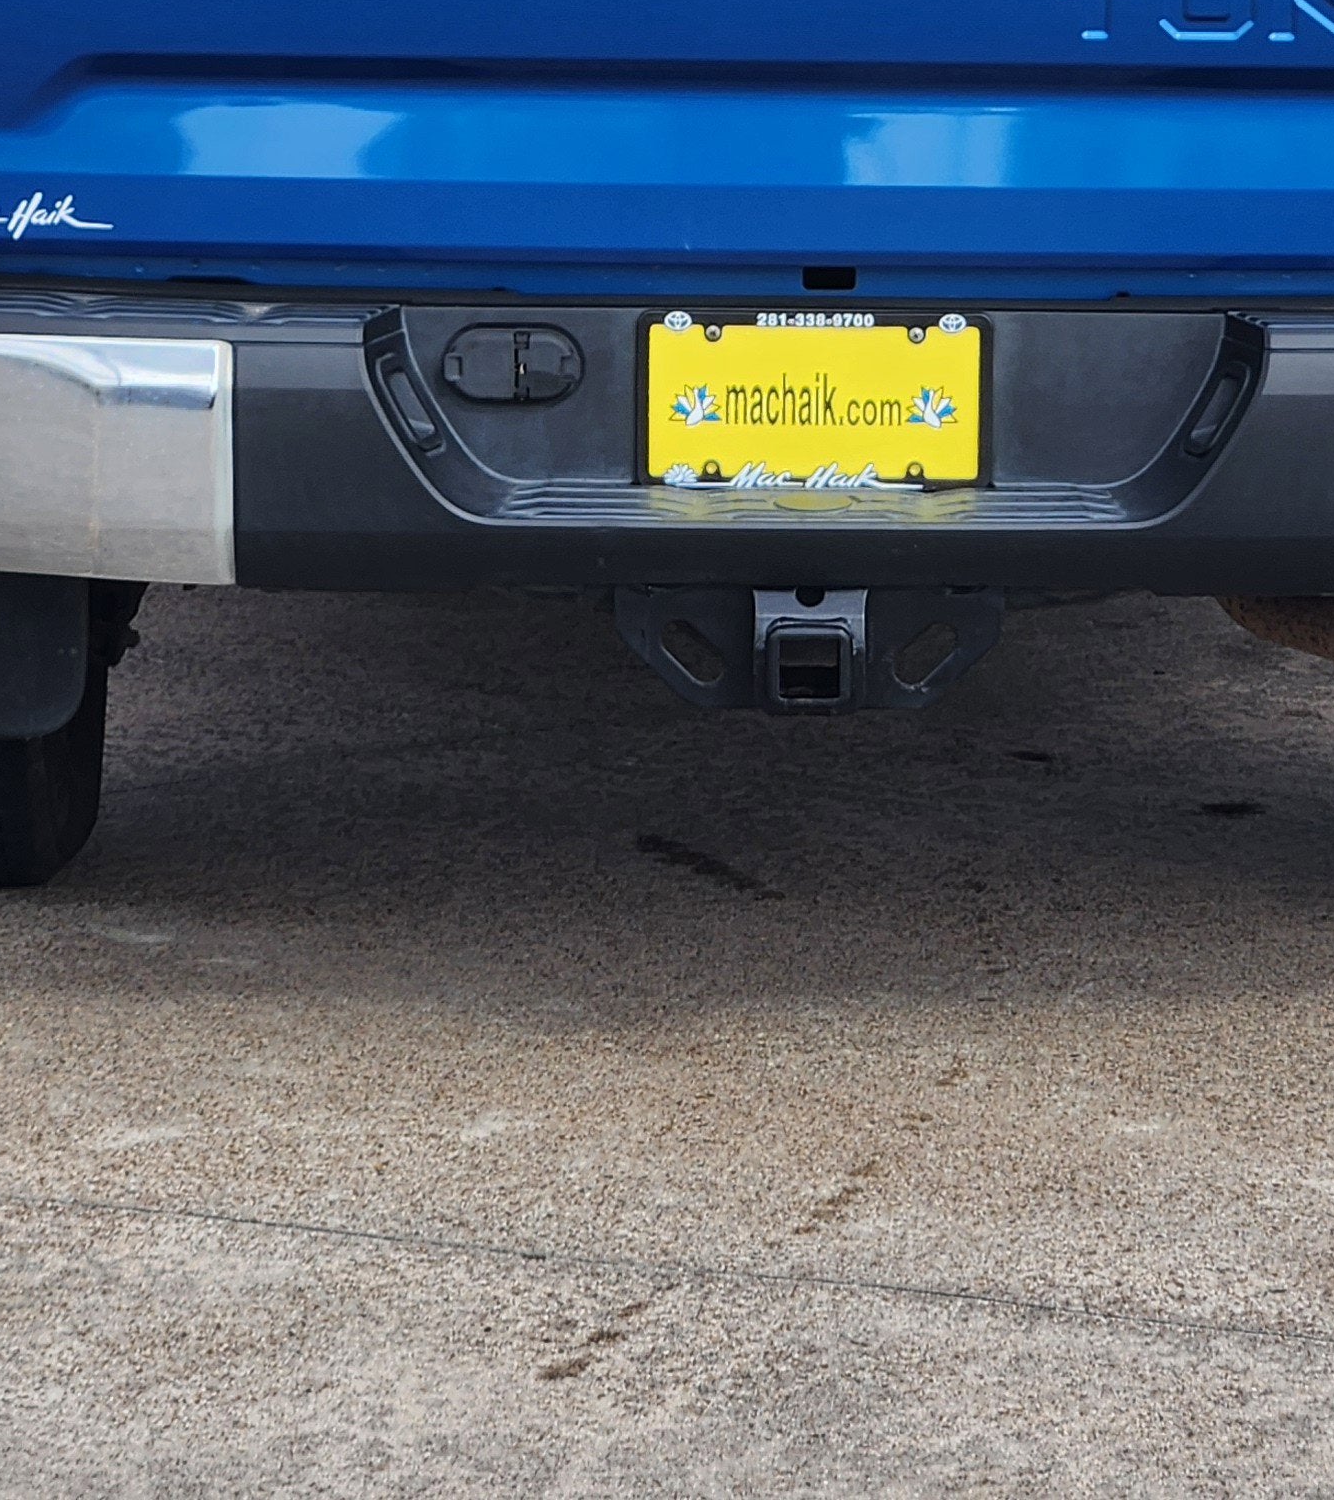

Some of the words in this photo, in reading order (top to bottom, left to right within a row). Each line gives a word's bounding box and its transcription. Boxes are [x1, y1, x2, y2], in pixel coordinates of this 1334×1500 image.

[7, 191, 115, 240] Haik
[724, 372, 902, 427] machaik.com
[709, 461, 804, 489] Mac
[803, 461, 924, 489] Haik
